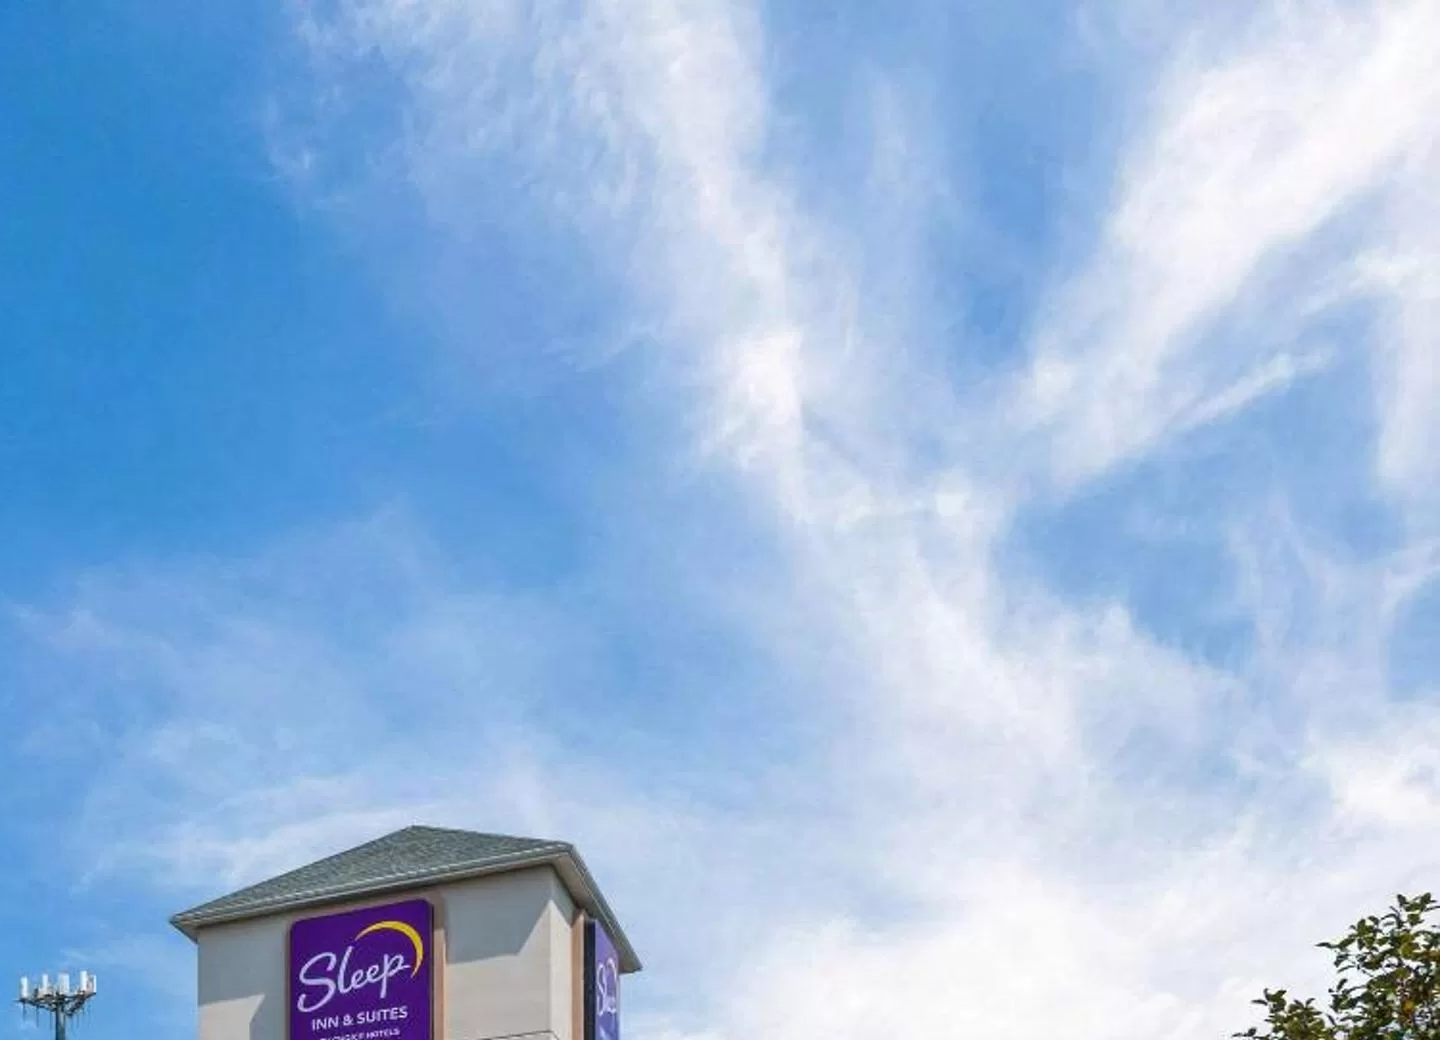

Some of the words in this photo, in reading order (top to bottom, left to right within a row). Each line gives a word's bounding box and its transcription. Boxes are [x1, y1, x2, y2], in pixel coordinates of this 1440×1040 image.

[297, 945, 411, 1012] Sleep
[312, 1015, 339, 1031] INN
[357, 1005, 408, 1025] SUITES
